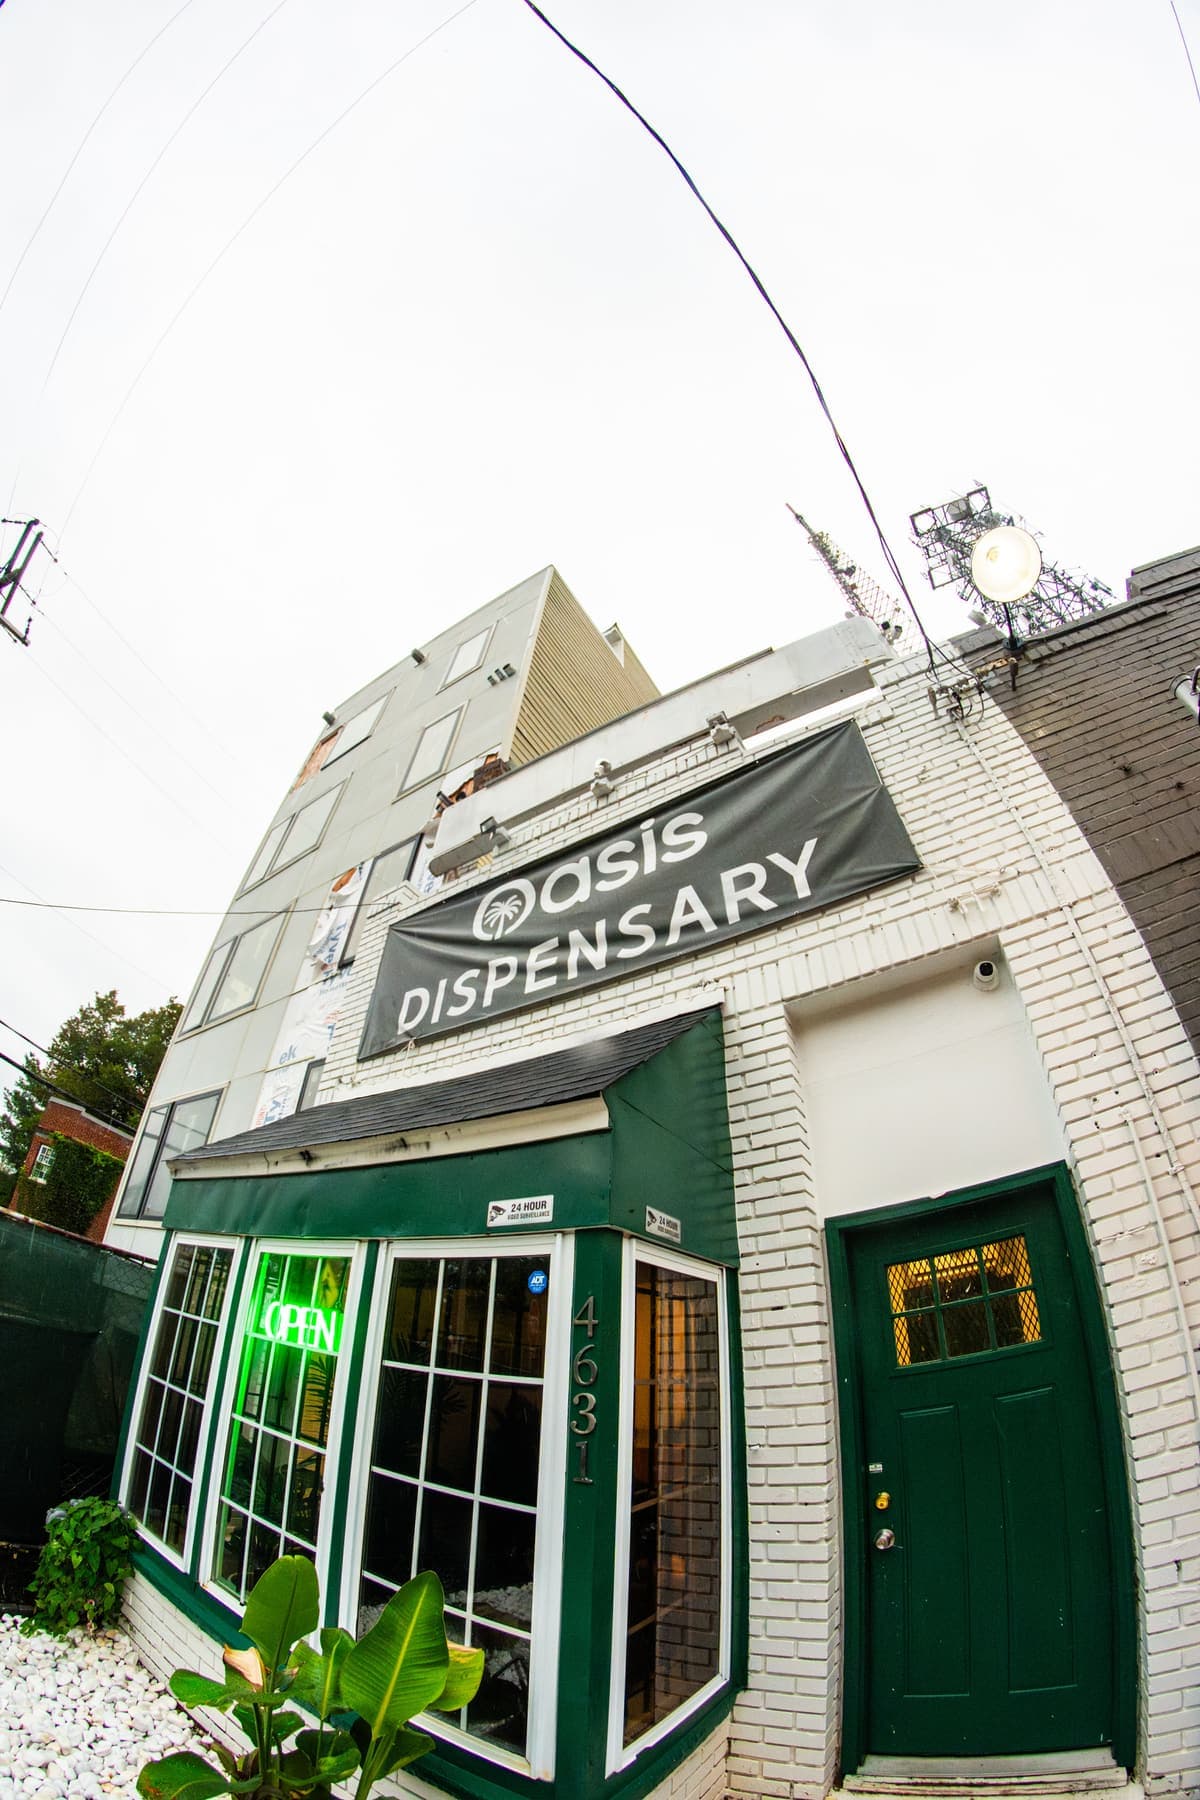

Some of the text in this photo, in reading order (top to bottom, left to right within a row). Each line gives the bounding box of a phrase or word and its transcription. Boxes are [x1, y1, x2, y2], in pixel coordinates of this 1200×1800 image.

[473, 811, 708, 942] Oasis
[396, 837, 819, 1036] DISPENSARY
[511, 1200, 547, 1213] 24 HOUR
[530, 1275, 545, 1284] ADT
[264, 1301, 337, 1352] OPEN
[570, 1296, 599, 1484] 4631
